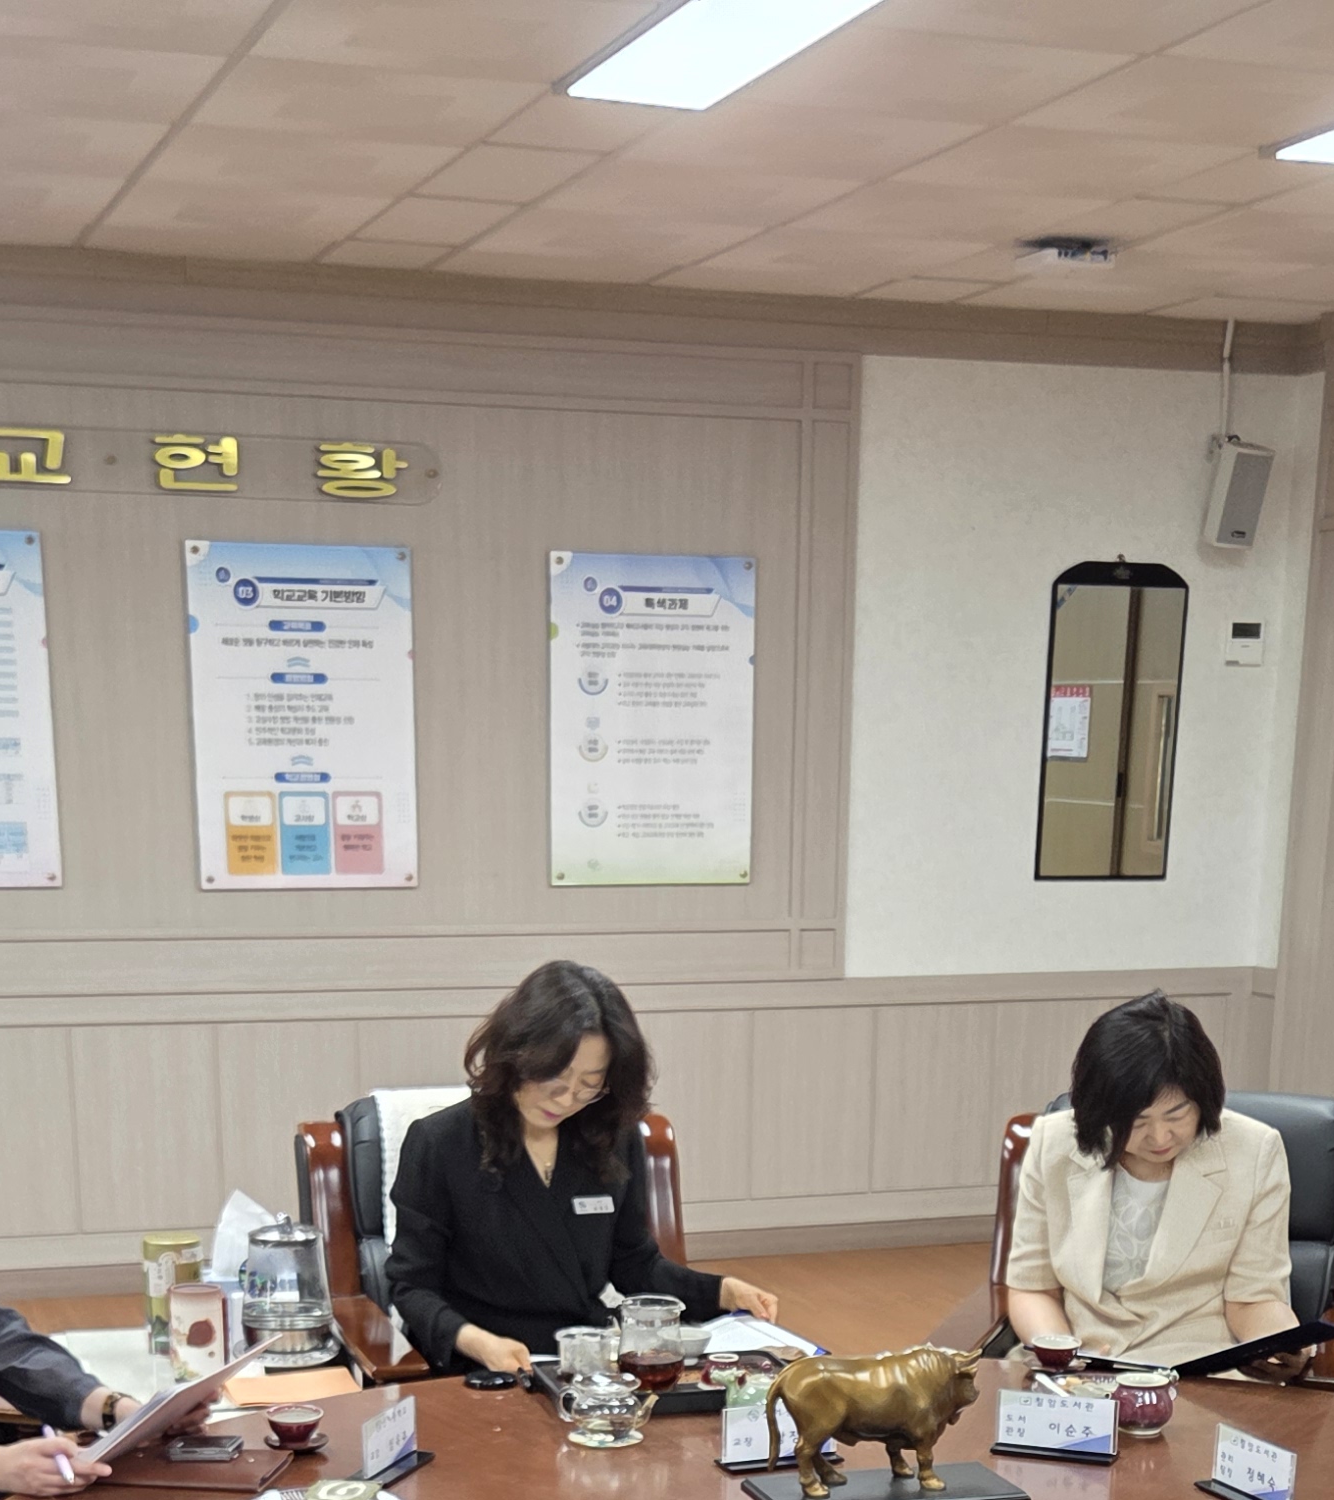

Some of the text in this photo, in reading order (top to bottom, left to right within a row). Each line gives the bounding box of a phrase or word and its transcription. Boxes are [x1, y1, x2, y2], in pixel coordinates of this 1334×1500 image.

[238, 587, 254, 599] 03
[272, 589, 366, 604] 학교교육 기본방향
[603, 596, 618, 607] 04
[644, 598, 689, 610] 특색과제
[1048, 1422, 1095, 1438] 이순주
